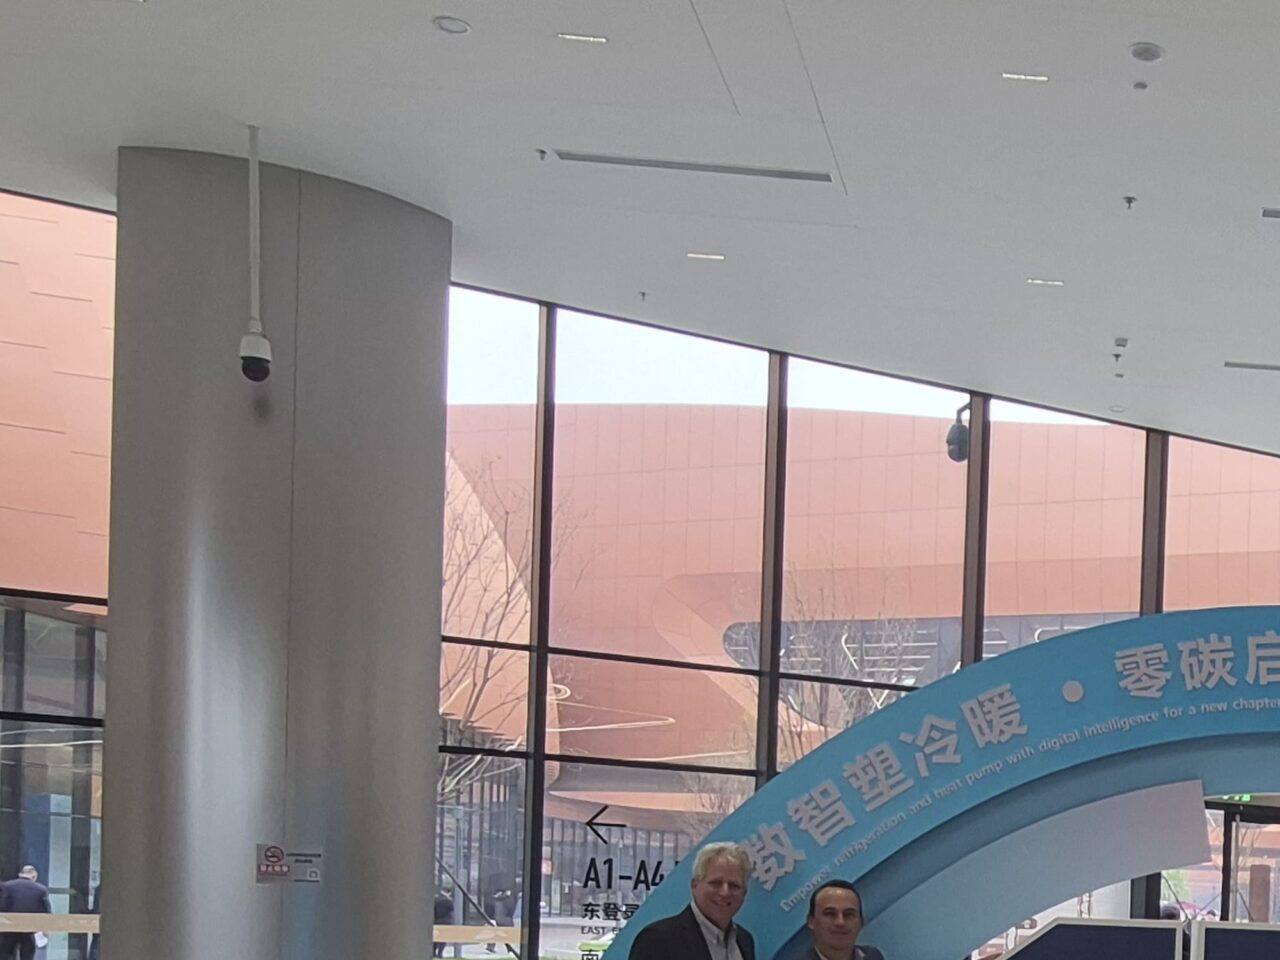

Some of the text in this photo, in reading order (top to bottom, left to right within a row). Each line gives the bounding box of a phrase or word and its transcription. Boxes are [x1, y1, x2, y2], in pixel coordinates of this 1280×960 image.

[779, 865, 832, 912] Empower
[834, 811, 907, 866] refrigeration
[910, 796, 932, 816] and
[933, 778, 963, 799] heat
[965, 759, 1003, 786] pump
[1006, 745, 1035, 765] with
[1038, 730, 1080, 752] digital
[1084, 711, 1159, 737] intelligence
[1163, 704, 1184, 719] for
[1201, 701, 1228, 713] new
[582, 902, 640, 920] 东登录
[580, 925, 607, 935] EAST
